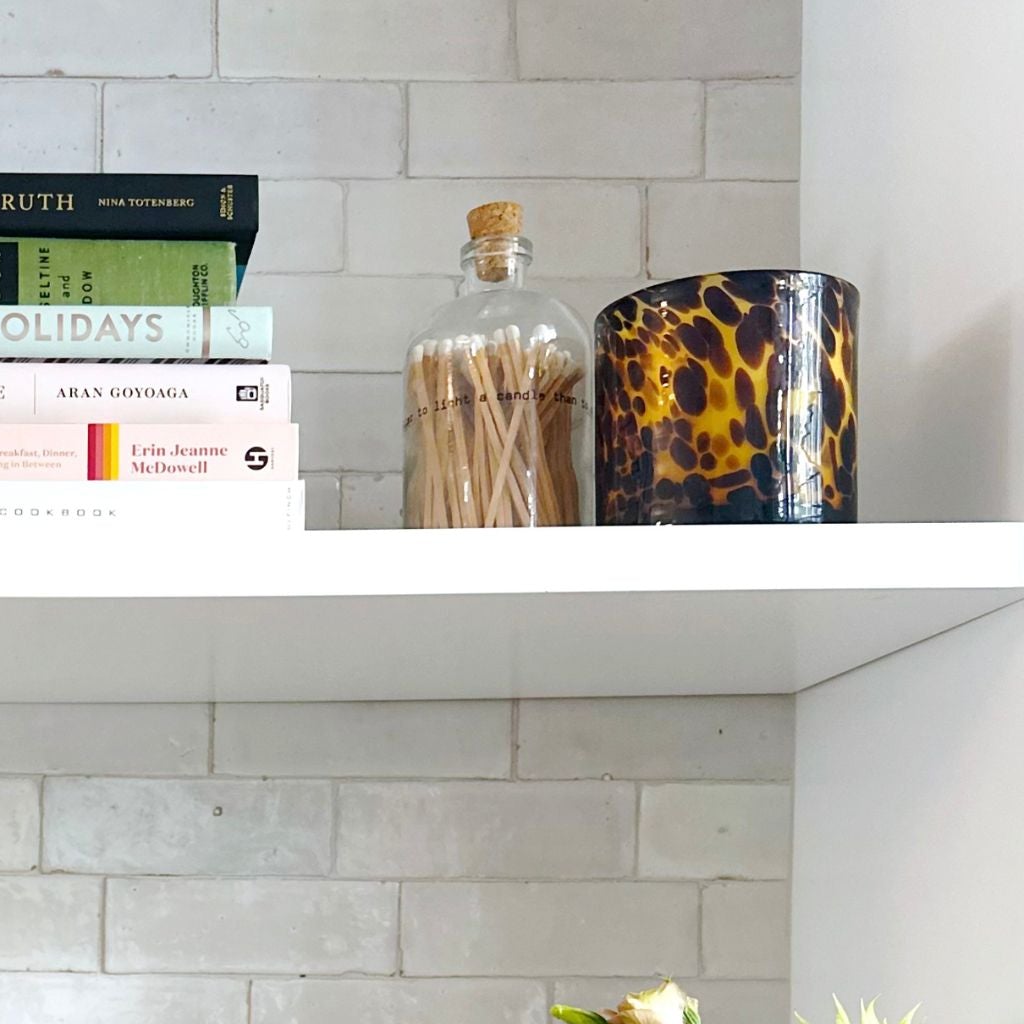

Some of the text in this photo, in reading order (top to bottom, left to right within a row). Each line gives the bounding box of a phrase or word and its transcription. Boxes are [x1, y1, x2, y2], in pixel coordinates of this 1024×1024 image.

[0, 194, 75, 211] RUTH
[98, 198, 195, 207] NINA TOTENBERG
[57, 275, 70, 298] and
[81, 270, 93, 305] DOW
[191, 264, 200, 307] OUGHTON
[57, 387, 189, 399] ARAN GOYOAGA
[417, 406, 428, 418] to
[479, 393, 488, 402] a
[496, 390, 546, 401] candle
[554, 392, 577, 405] than
[42, 449, 78, 459] Dinner,
[131, 444, 229, 458] Erin Jeanne
[131, 461, 208, 475] McDowell
[0, 508, 117, 517] COOKBOOK
